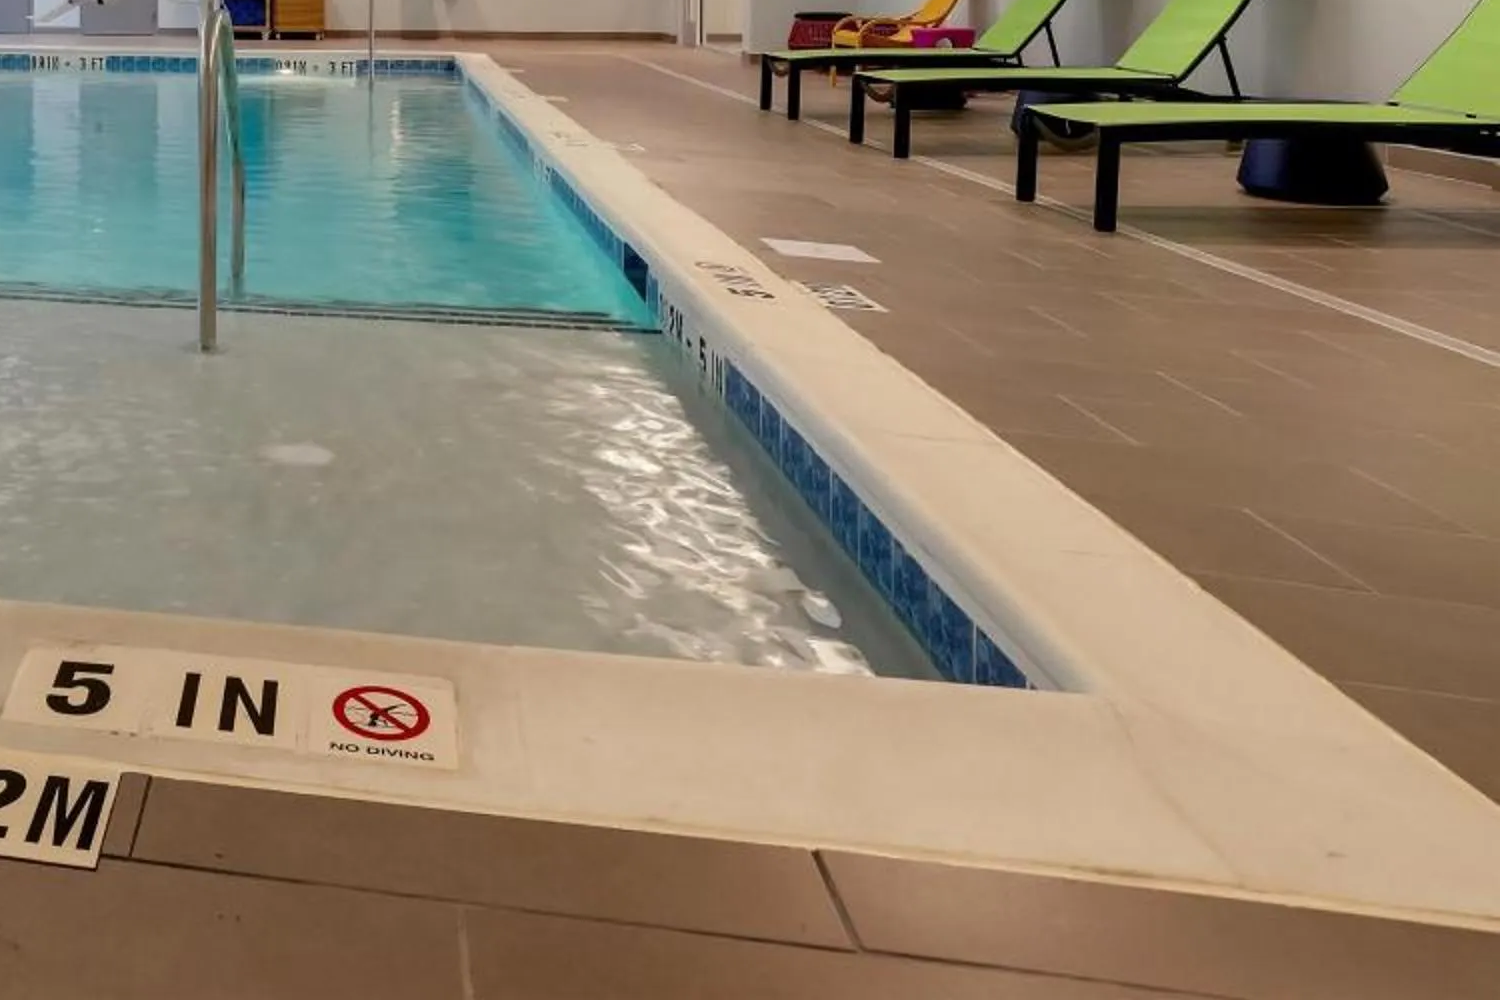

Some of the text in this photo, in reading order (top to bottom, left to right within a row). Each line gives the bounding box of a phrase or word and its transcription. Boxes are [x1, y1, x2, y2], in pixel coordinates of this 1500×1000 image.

[91, 57, 104, 71] FT
[341, 61, 354, 76] FT
[45, 660, 279, 736] 5 IN
[329, 741, 436, 761] NO DIVING
